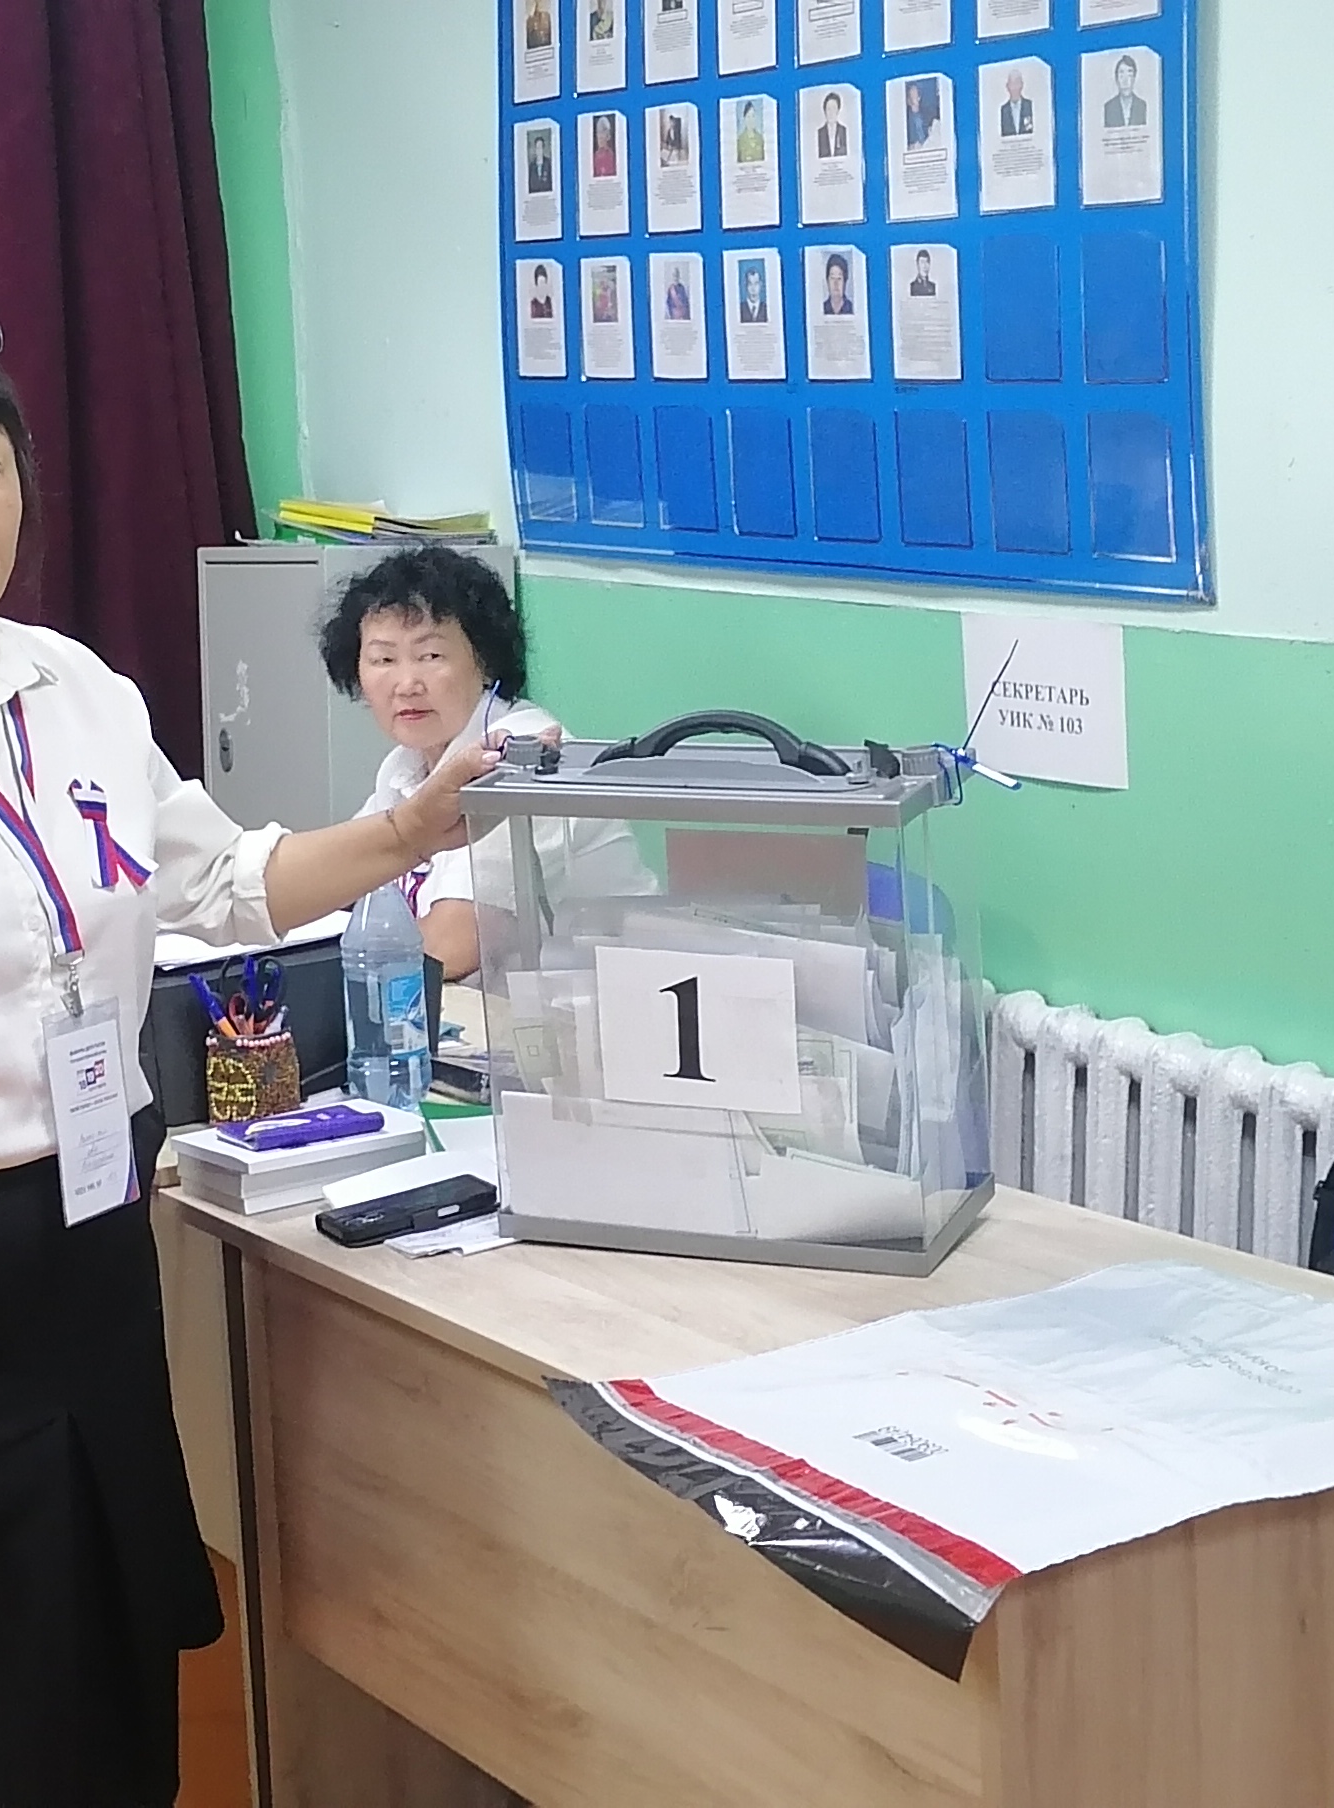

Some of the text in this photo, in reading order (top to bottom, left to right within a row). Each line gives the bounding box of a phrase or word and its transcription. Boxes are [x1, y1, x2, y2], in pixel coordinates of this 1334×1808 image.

[992, 681, 1089, 706] СЕКРЕТАРЬ
[998, 709, 1084, 735] УИК № 103
[659, 975, 717, 1083] 1
